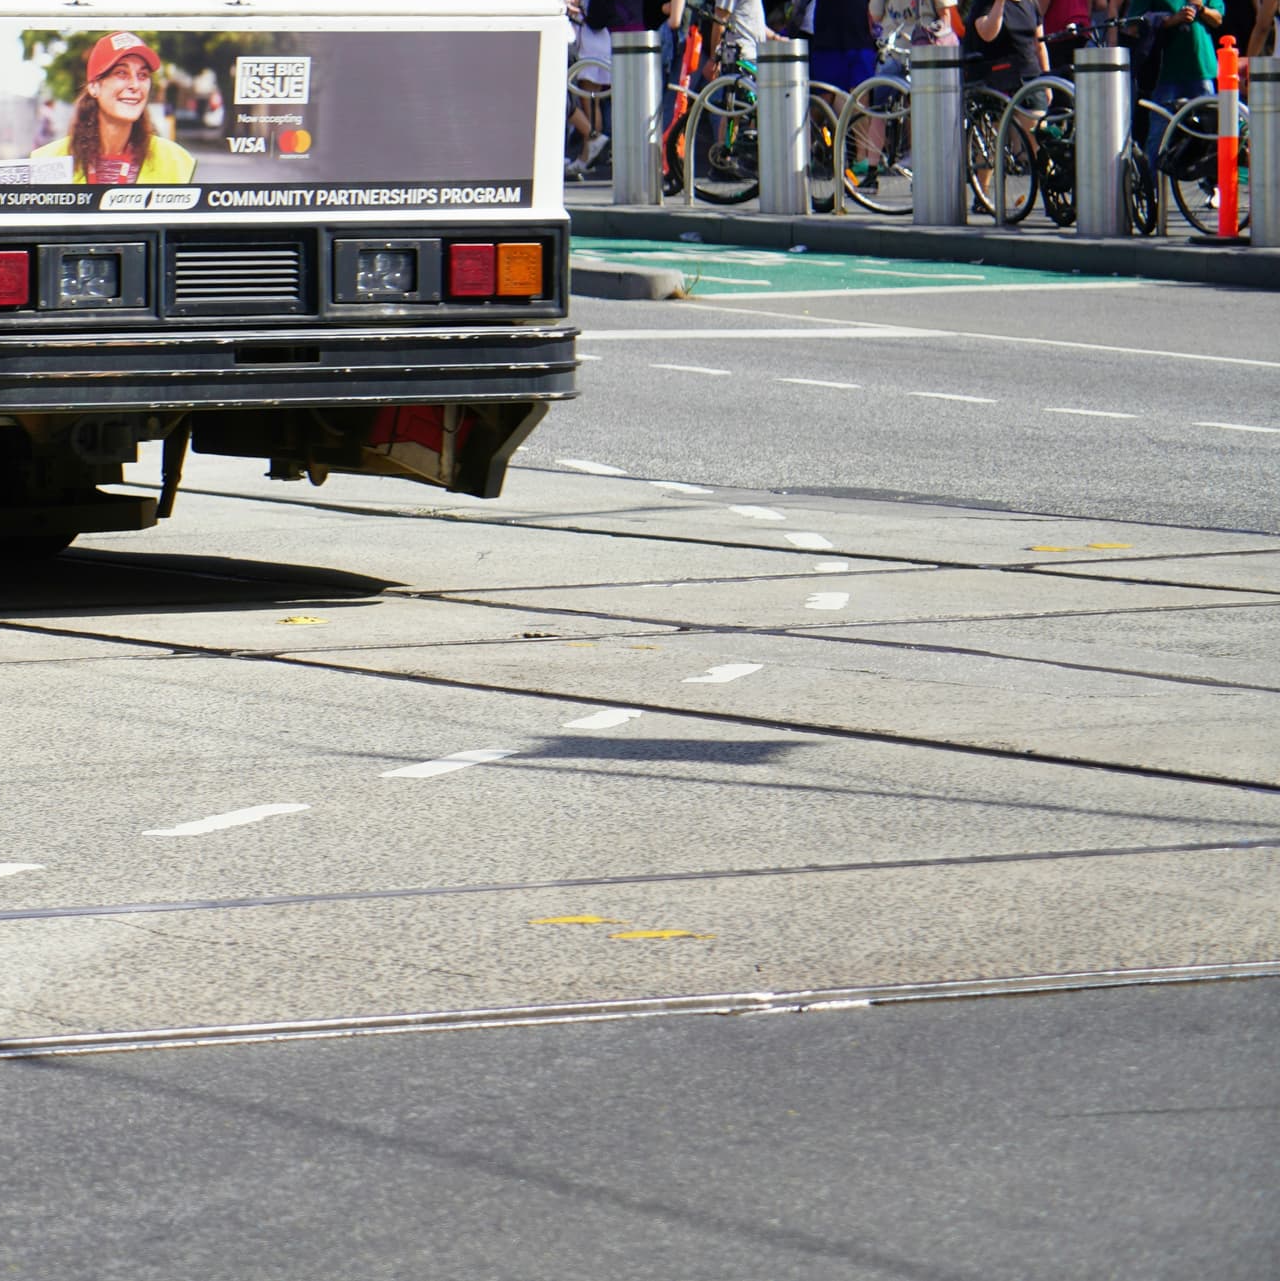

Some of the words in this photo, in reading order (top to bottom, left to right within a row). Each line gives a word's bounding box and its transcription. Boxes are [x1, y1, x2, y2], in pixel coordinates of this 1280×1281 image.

[241, 63, 275, 76] THE
[276, 63, 305, 76] BIG
[240, 76, 304, 98] ISSUE
[226, 136, 266, 153] VISA
[7, 191, 74, 207] SUPPORTED
[76, 192, 92, 206] BY
[109, 191, 143, 205] yarra
[154, 190, 191, 204] trams
[207, 188, 315, 207] COMMUNITY
[315, 187, 438, 207] PARTNERSHIPS
[439, 186, 521, 204] PROGRAM
